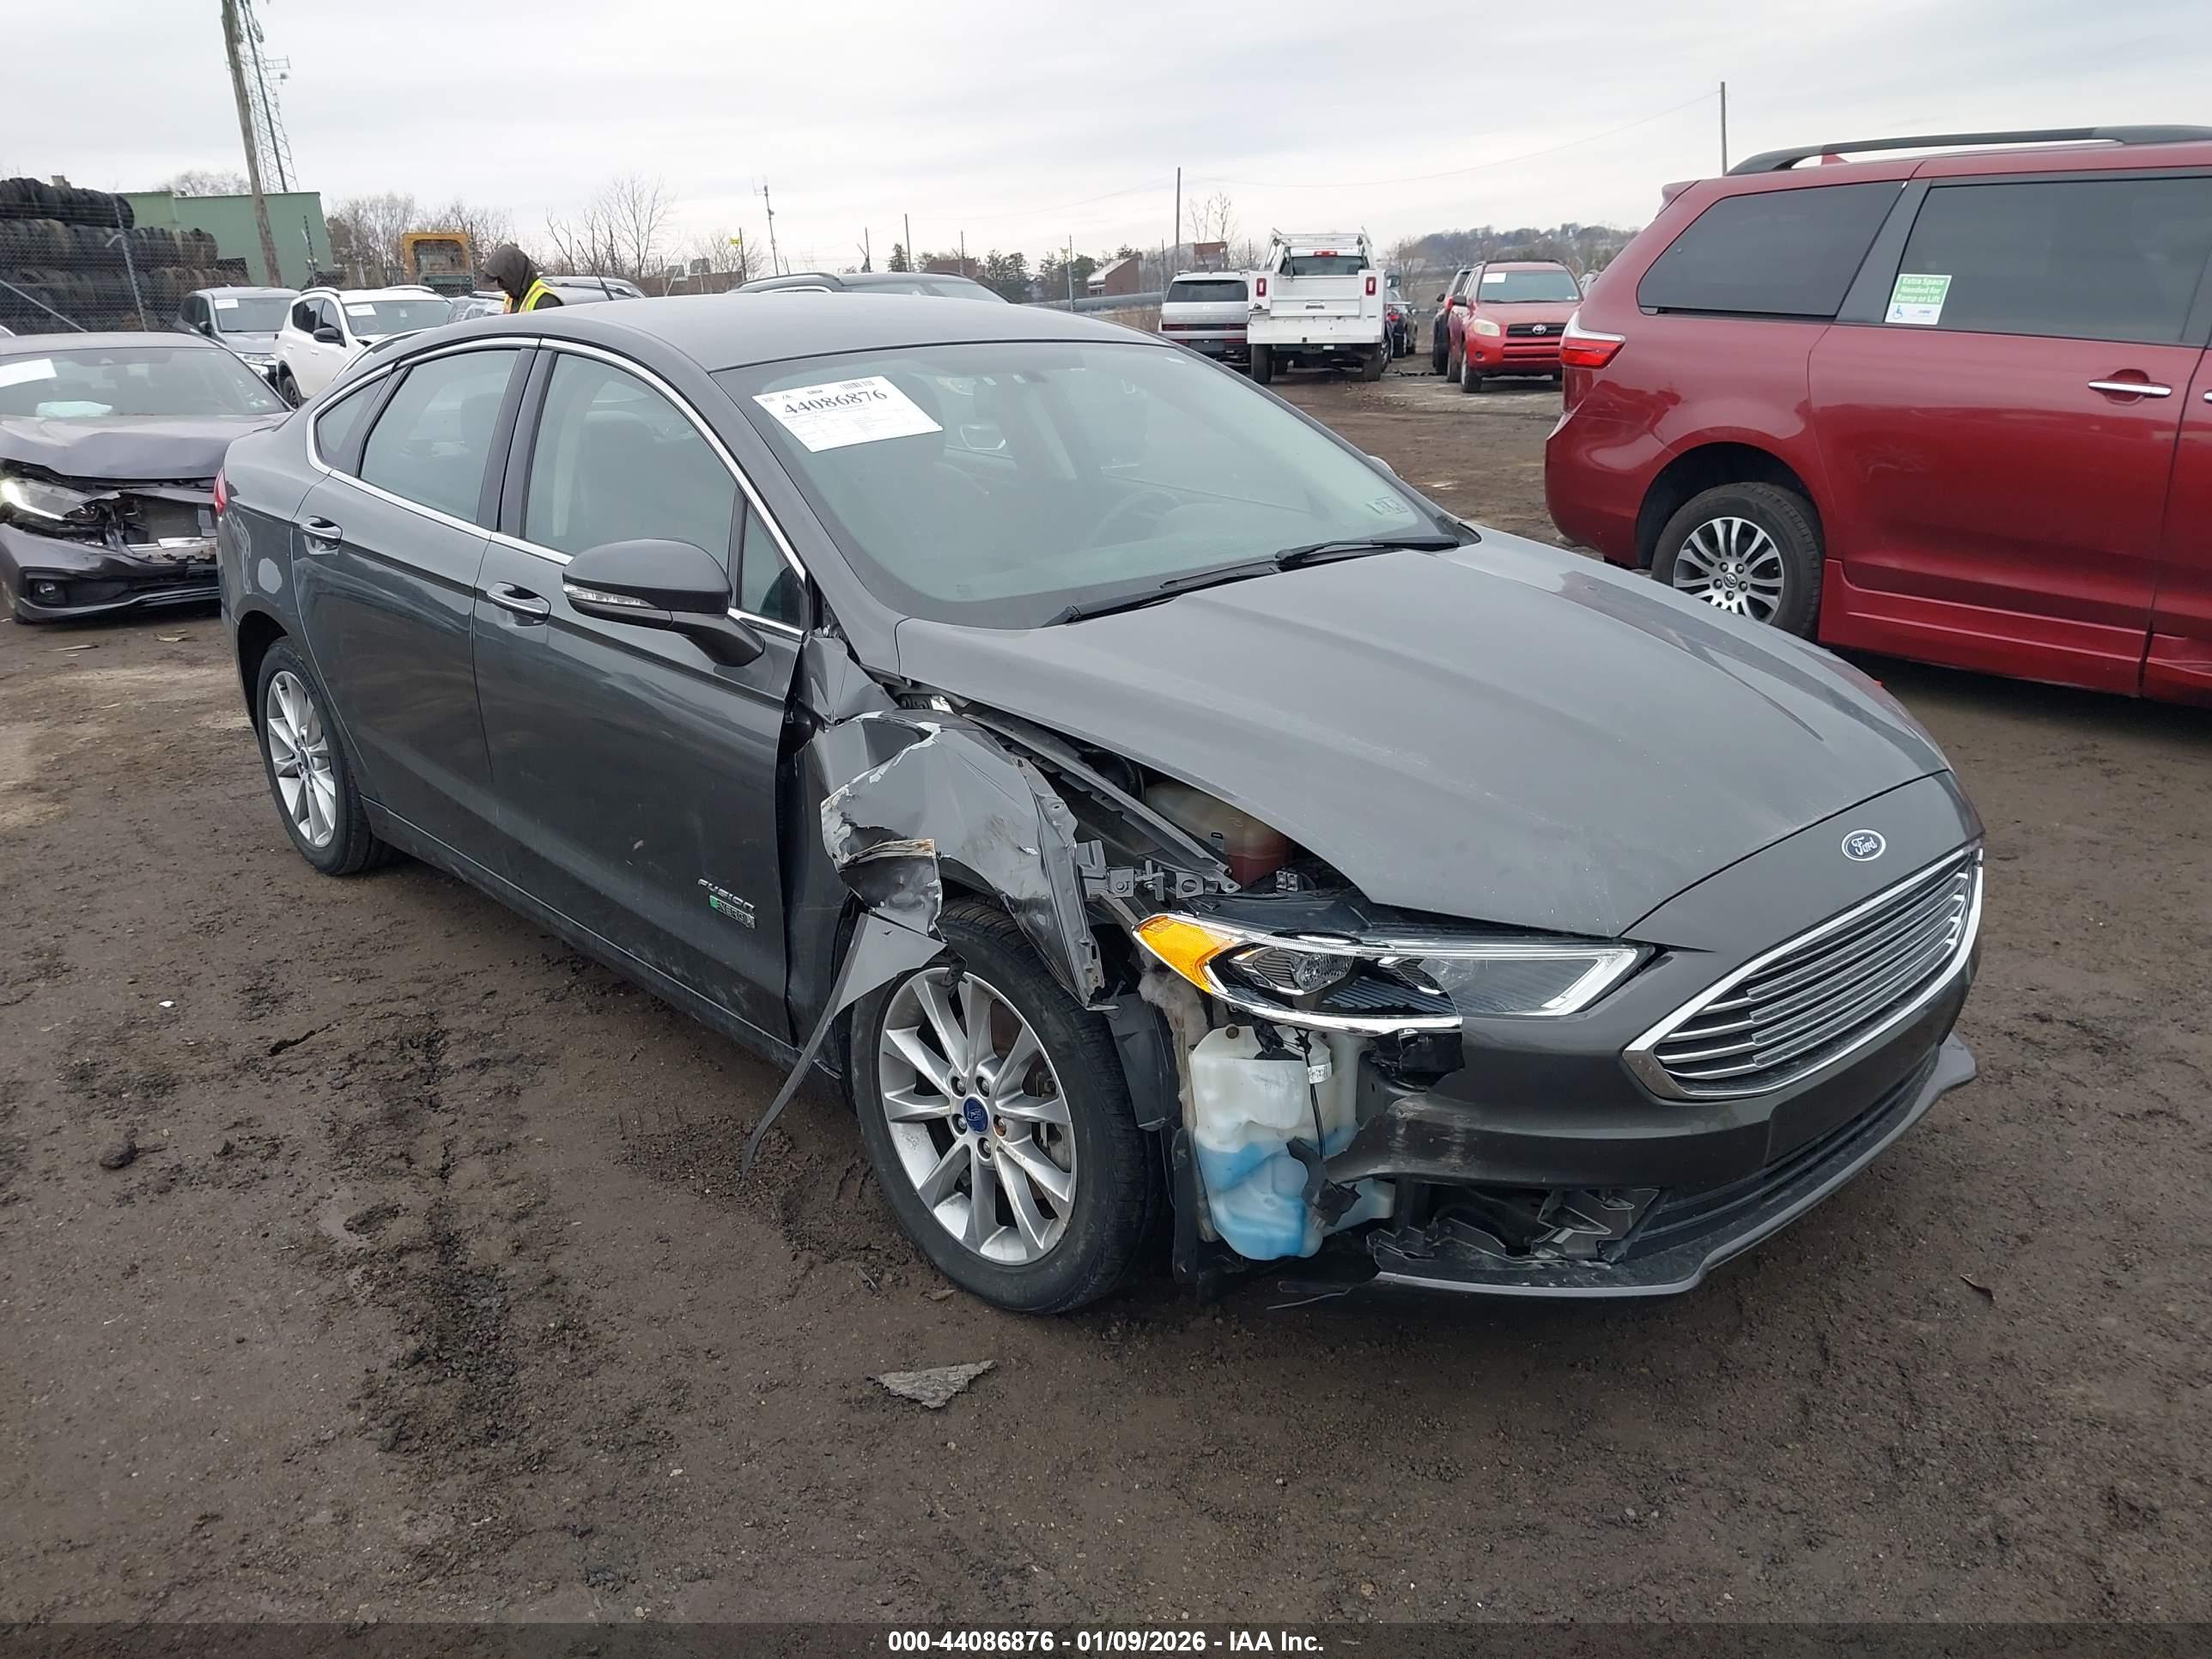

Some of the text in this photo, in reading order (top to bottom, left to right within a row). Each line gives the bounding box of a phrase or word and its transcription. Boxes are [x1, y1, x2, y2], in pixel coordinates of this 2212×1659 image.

[1923, 277, 1945, 286] Space
[785, 389, 888, 414] 44086876
[1850, 836, 1878, 856] Ford
[697, 878, 756, 911] FUSION
